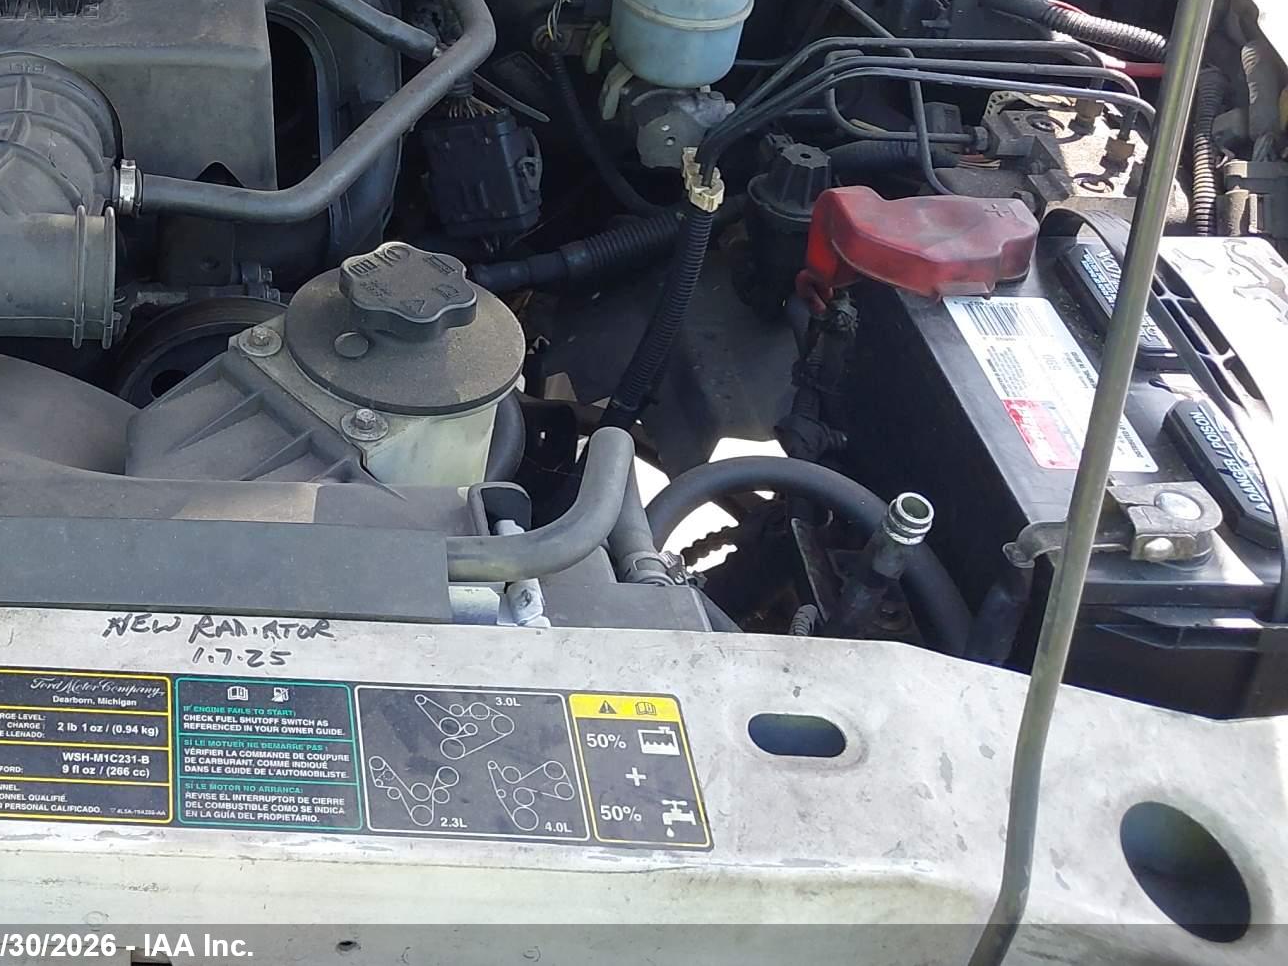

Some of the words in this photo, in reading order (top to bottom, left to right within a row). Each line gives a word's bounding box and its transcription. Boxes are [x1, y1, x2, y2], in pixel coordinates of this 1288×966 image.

[1190, 412, 1227, 450] POISON
[1223, 458, 1265, 502] DANGER
[103, 613, 182, 638] NEW
[188, 615, 336, 643] RADIATOR
[192, 646, 292, 668] 1.7.25
[30, 677, 63, 691] Ford
[57, 679, 99, 694] Motor
[99, 678, 165, 699] Company
[52, 695, 95, 705] Dearborn,
[97, 697, 137, 707] Michigan
[495, 697, 522, 707] 3.0L
[18, 713, 46, 721] LEVEL:
[239, 717, 279, 725] SHUTOFF
[281, 718, 314, 726] SWITCH
[6, 730, 45, 738] LLENADO:
[57, 722, 64, 731] 2
[67, 722, 77, 732] lb
[81, 723, 87, 732] 1
[90, 725, 103, 733] oz
[112, 724, 138, 735] (0.94
[141, 725, 159, 737] kg)
[183, 722, 242, 731] REFERENCED
[254, 725, 279, 733] YOUR
[281, 726, 313, 734] OWNER
[316, 728, 345, 736] GUIDE.
[586, 733, 627, 749] 50%
[62, 752, 150, 764] WSH-M1C231-B
[184, 756, 197, 764] DE
[256, 759, 290, 768] COMME
[239, 750, 290, 759] COMMANDE
[308, 753, 350, 762] COUPURE
[62, 765, 69, 774] 9
[72, 765, 80, 774] fl
[82, 767, 96, 775] oz
[106, 766, 130, 777] (266
[132, 768, 150, 778] cc)
[225, 767, 252, 775] GUIDE
[185, 792, 217, 801] REVISE
[232, 794, 295, 803] INTERRUPTOR
[312, 797, 344, 805] CIERRE
[4, 803, 49, 811] PERSONAL
[51, 804, 102, 813] CALIFICADO.
[205, 802, 269, 811] COMBUSTIBLE
[271, 804, 298, 813] COMO
[315, 806, 345, 814] INDICA
[600, 805, 642, 822] 50%
[238, 812, 255, 820] DEL
[258, 813, 320, 823] PROPIETARIO.
[440, 817, 468, 828] 2.3L
[544, 821, 573, 833] 4.0L
